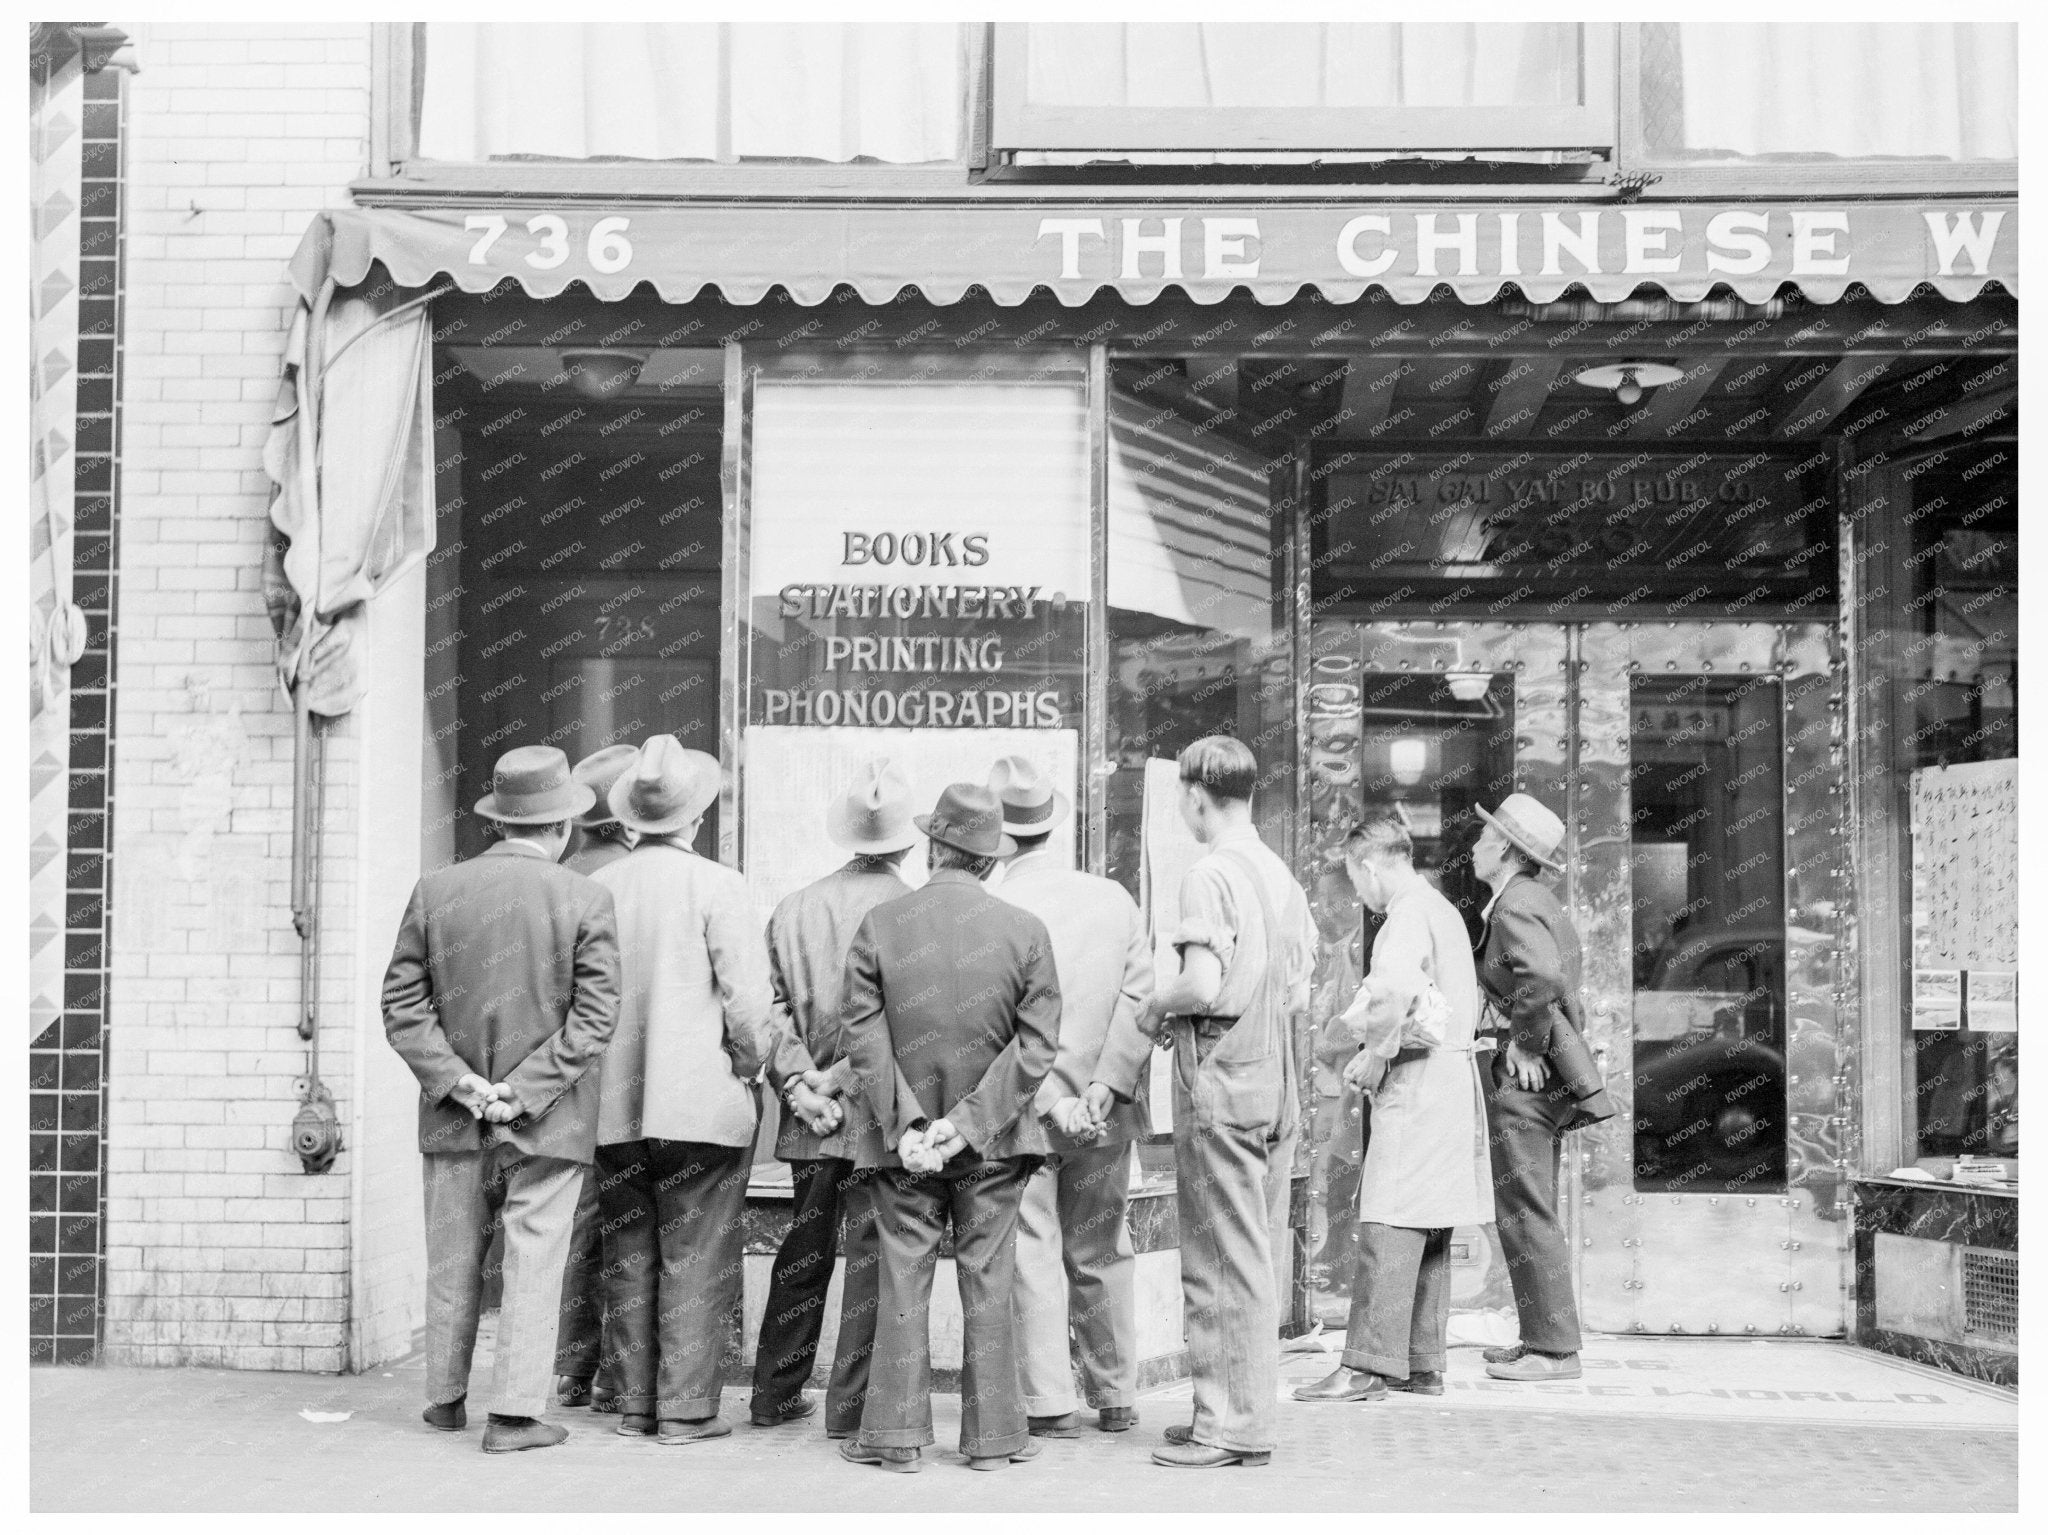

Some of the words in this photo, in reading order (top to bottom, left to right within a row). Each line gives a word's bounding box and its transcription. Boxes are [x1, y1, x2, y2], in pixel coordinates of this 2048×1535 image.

[464, 214, 634, 274] 736
[1037, 217, 1261, 279] THE
[1336, 210, 1852, 278] CHINESE
[1507, 480, 1567, 502] YAT
[1580, 479, 1616, 502] BO
[841, 531, 990, 567] BOOKS
[779, 583, 1043, 620] STATIONERY
[824, 636, 1006, 673] PRINTING
[761, 689, 1063, 729] PHONOGRAPHS
